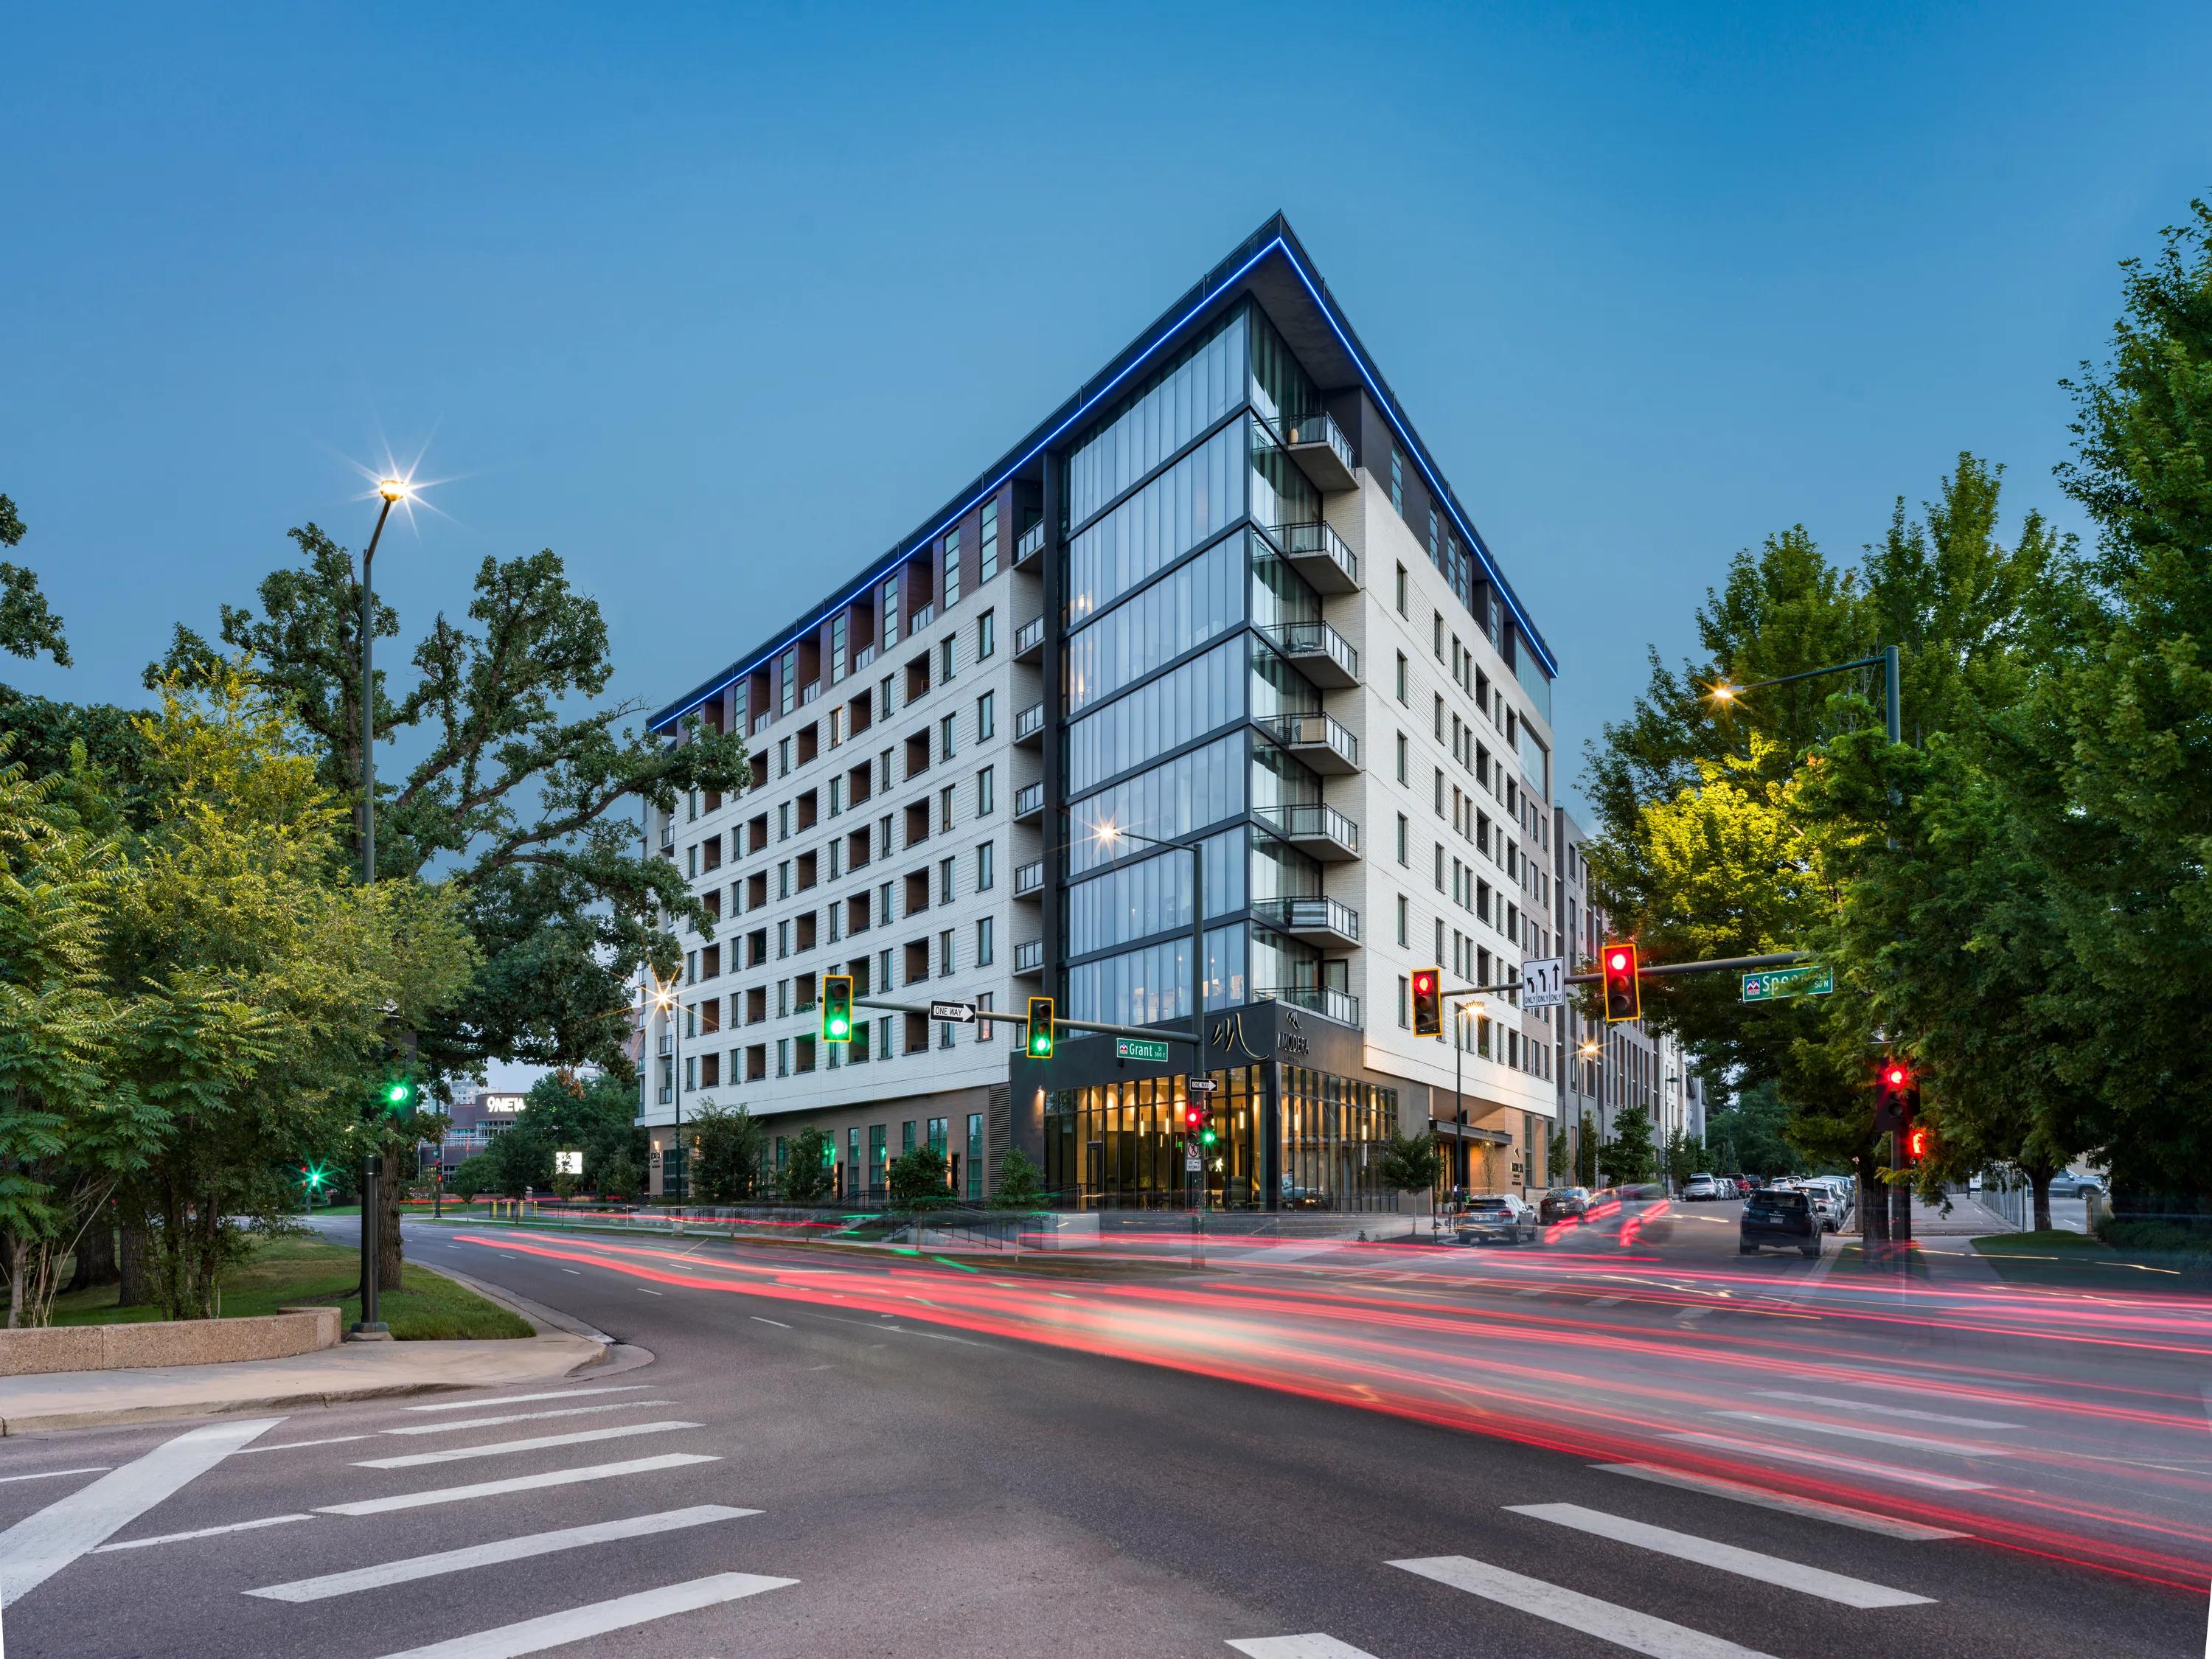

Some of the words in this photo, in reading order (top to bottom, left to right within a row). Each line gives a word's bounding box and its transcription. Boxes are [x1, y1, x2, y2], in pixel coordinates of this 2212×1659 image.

[1537, 995, 1549, 1003] ONLY
[1551, 993, 1562, 1001] ONLY
[935, 1006, 948, 1015] ONE
[950, 1007, 962, 1017] WAY
[1278, 1032, 1310, 1055] MODERA
[1129, 1043, 1153, 1057] Grant
